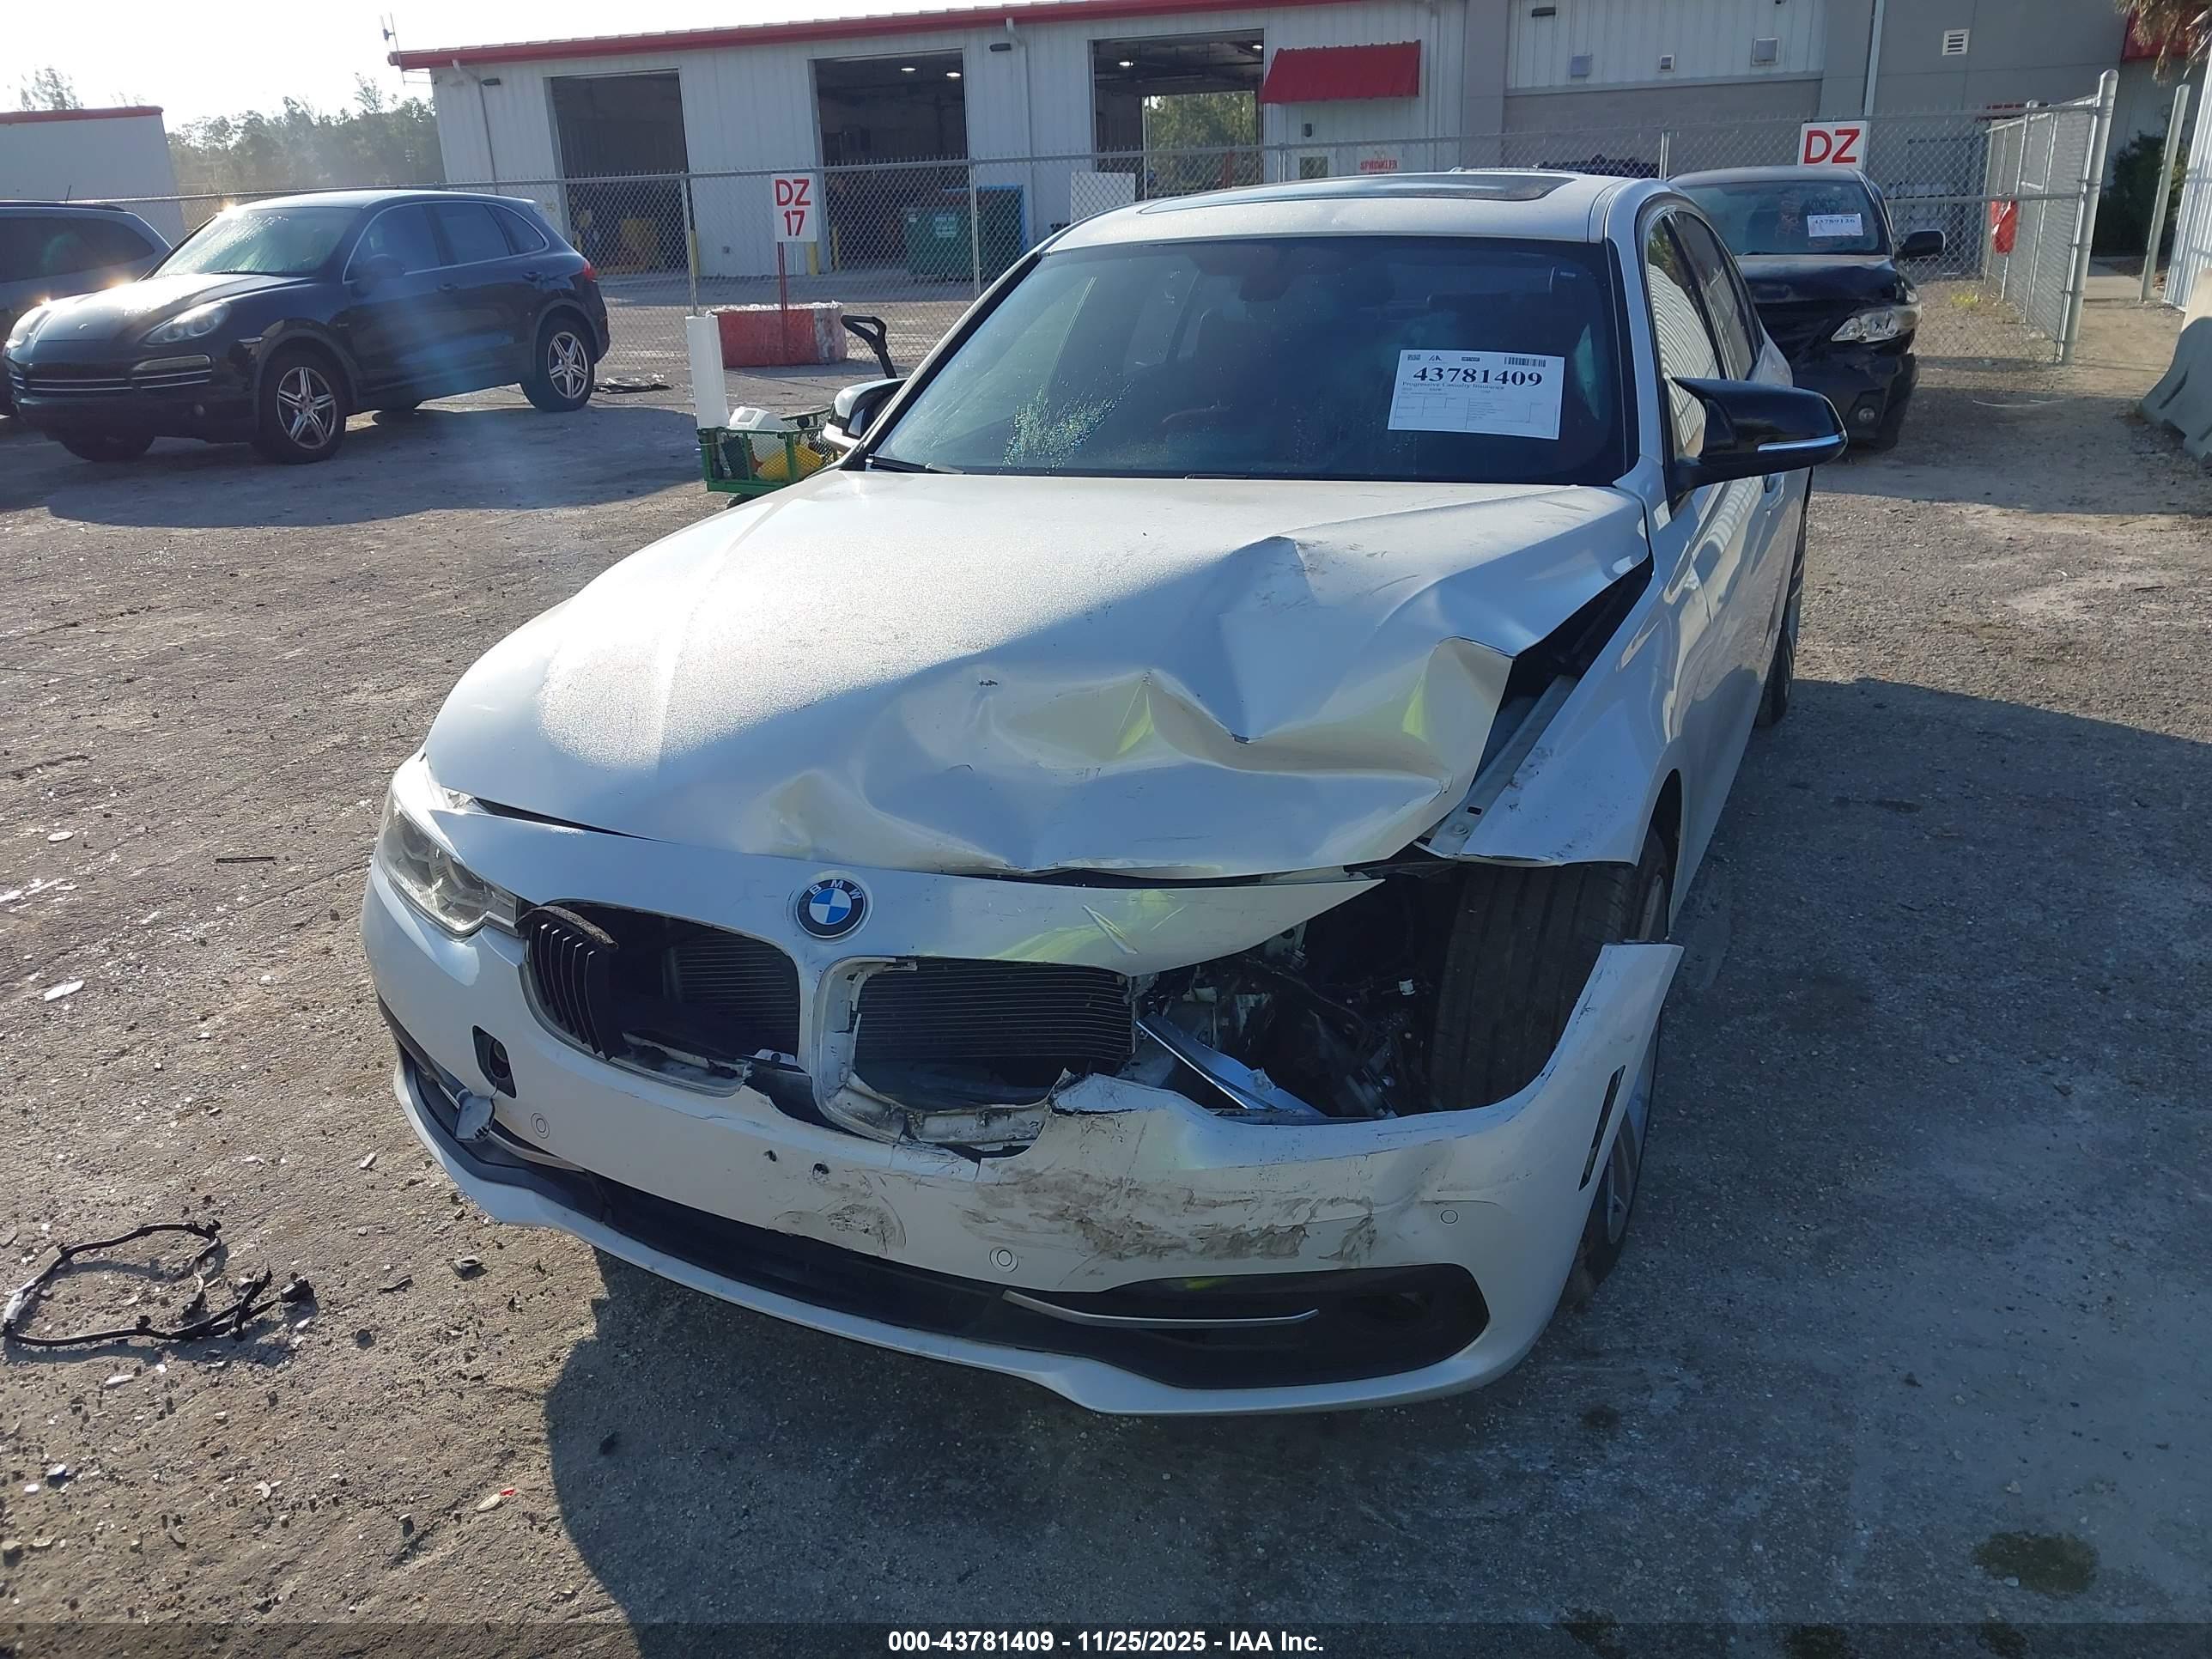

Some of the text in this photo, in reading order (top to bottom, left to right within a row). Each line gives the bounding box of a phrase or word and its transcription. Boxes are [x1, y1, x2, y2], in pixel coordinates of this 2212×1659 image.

[1803, 129, 1860, 164] DZ
[775, 178, 811, 206] DZ
[783, 210, 805, 236] 17
[1413, 367, 1543, 387] 43781409
[808, 879, 862, 900] BMW
